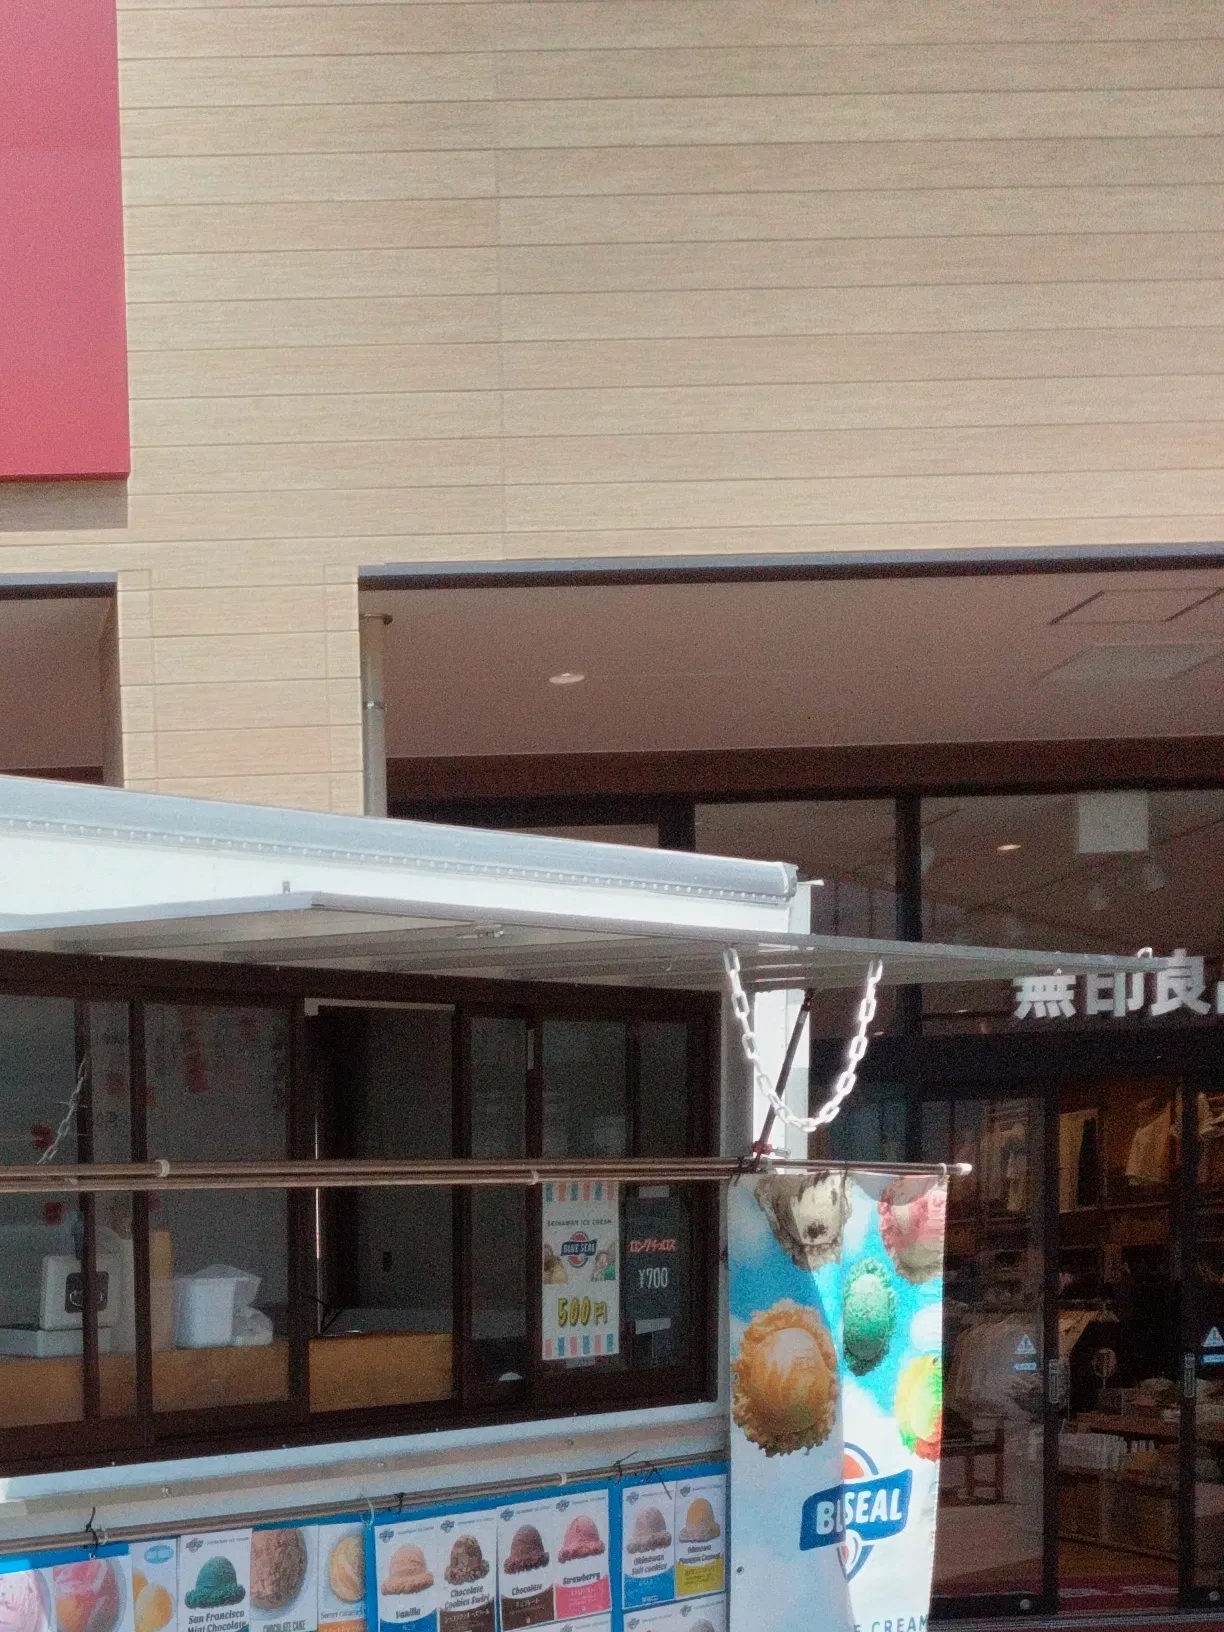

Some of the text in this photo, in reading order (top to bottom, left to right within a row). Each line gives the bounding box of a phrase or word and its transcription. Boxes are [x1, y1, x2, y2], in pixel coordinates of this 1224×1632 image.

[1012, 948, 1224, 1020] 無印良
[638, 1266, 669, 1290] ¥700
[557, 1295, 608, 1328] 500円
[843, 1487, 903, 1526] SEAL
[562, 1571, 601, 1586] Strawberry
[188, 1609, 245, 1625] San Francisco
[396, 1607, 421, 1620] Vanilla
[293, 1618, 306, 1632] CAKE
